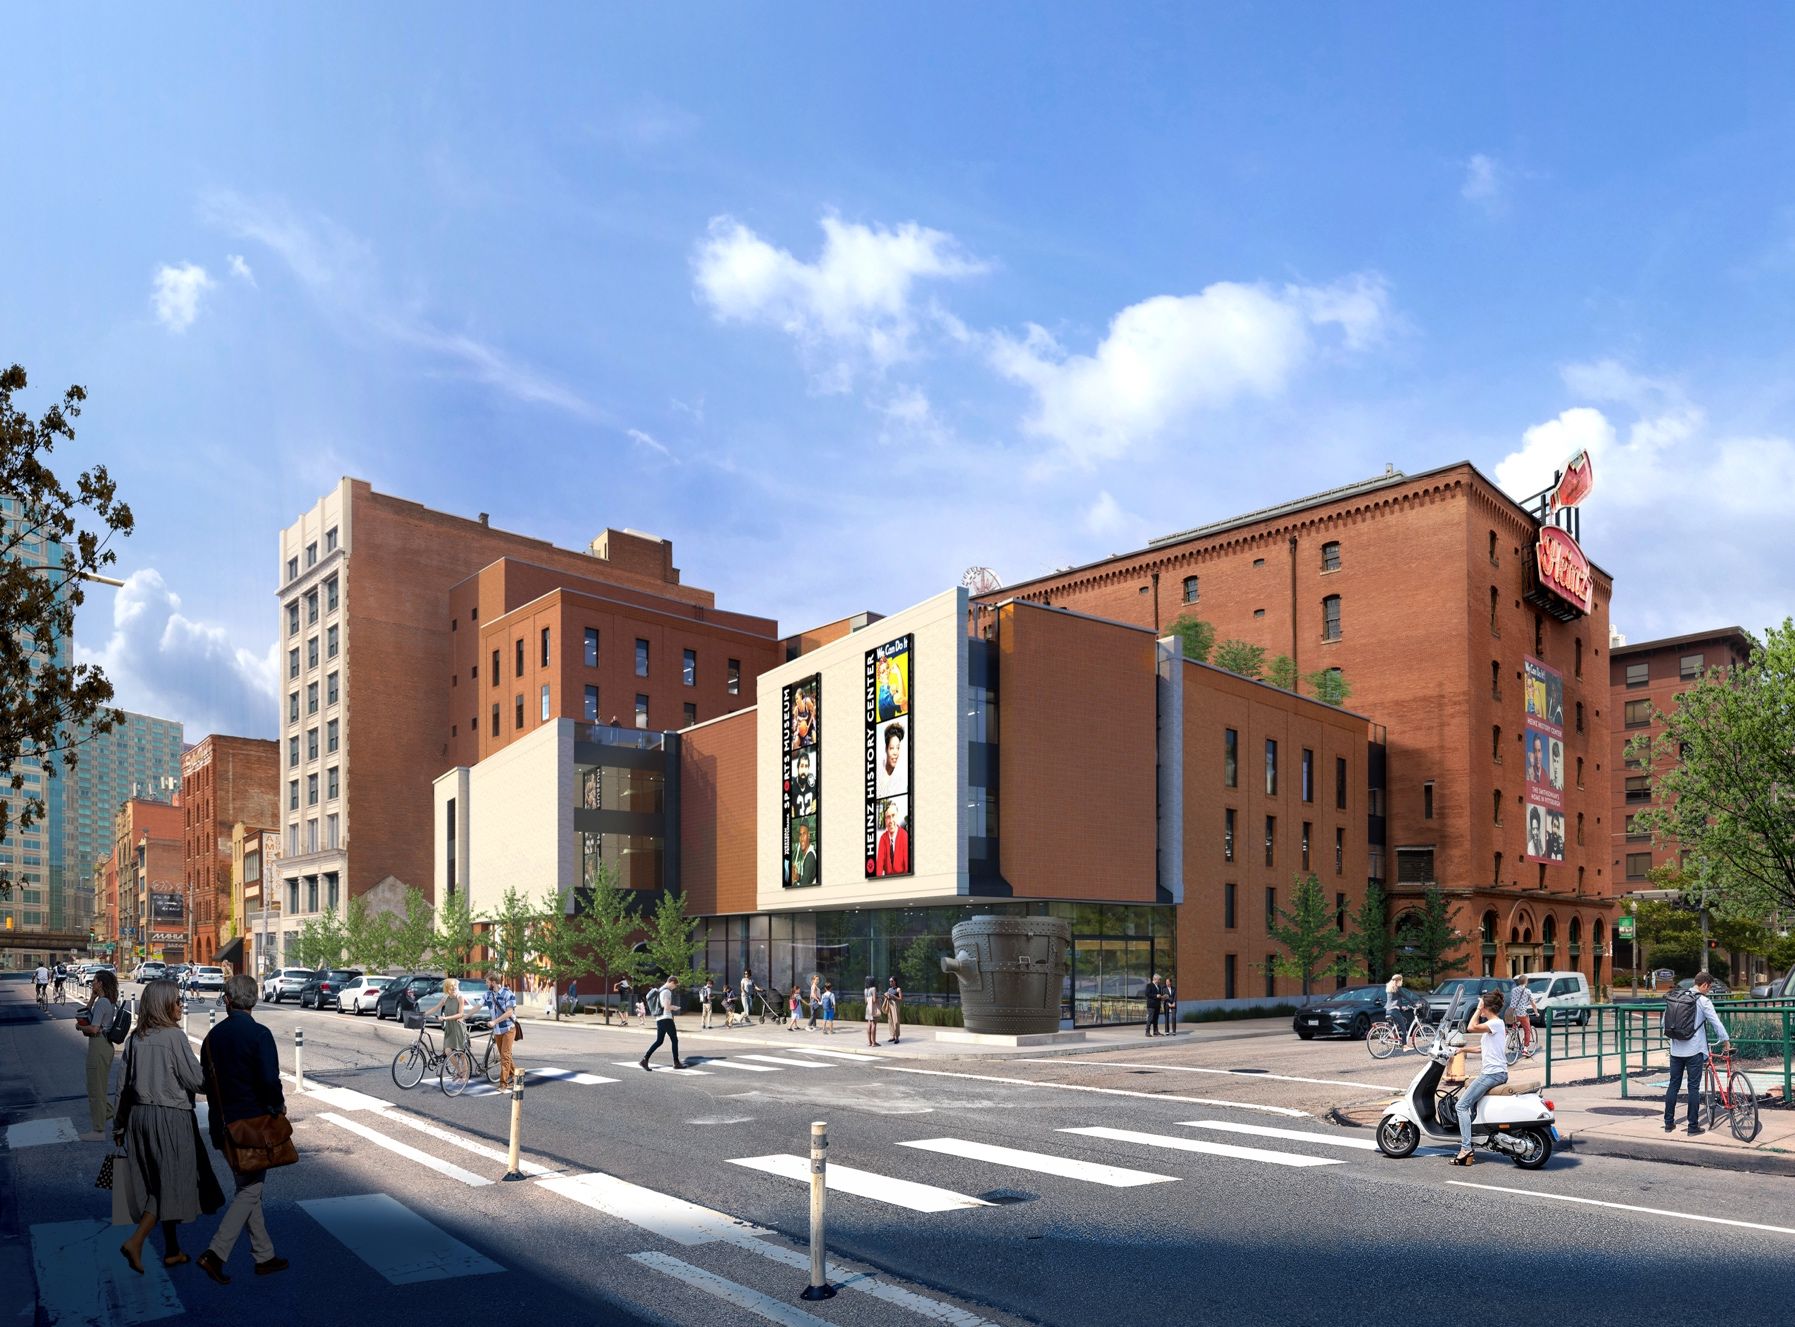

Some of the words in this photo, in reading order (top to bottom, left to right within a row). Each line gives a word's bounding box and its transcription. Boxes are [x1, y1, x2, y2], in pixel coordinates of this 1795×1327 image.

[1541, 535, 1588, 602] Heinz
[885, 644, 896, 656] Can
[895, 640, 903, 652] Do
[866, 653, 875, 722] CENTER
[783, 755, 791, 809] SPORTS
[866, 728, 875, 799] HISTORY
[866, 802, 875, 856] HEINZ
